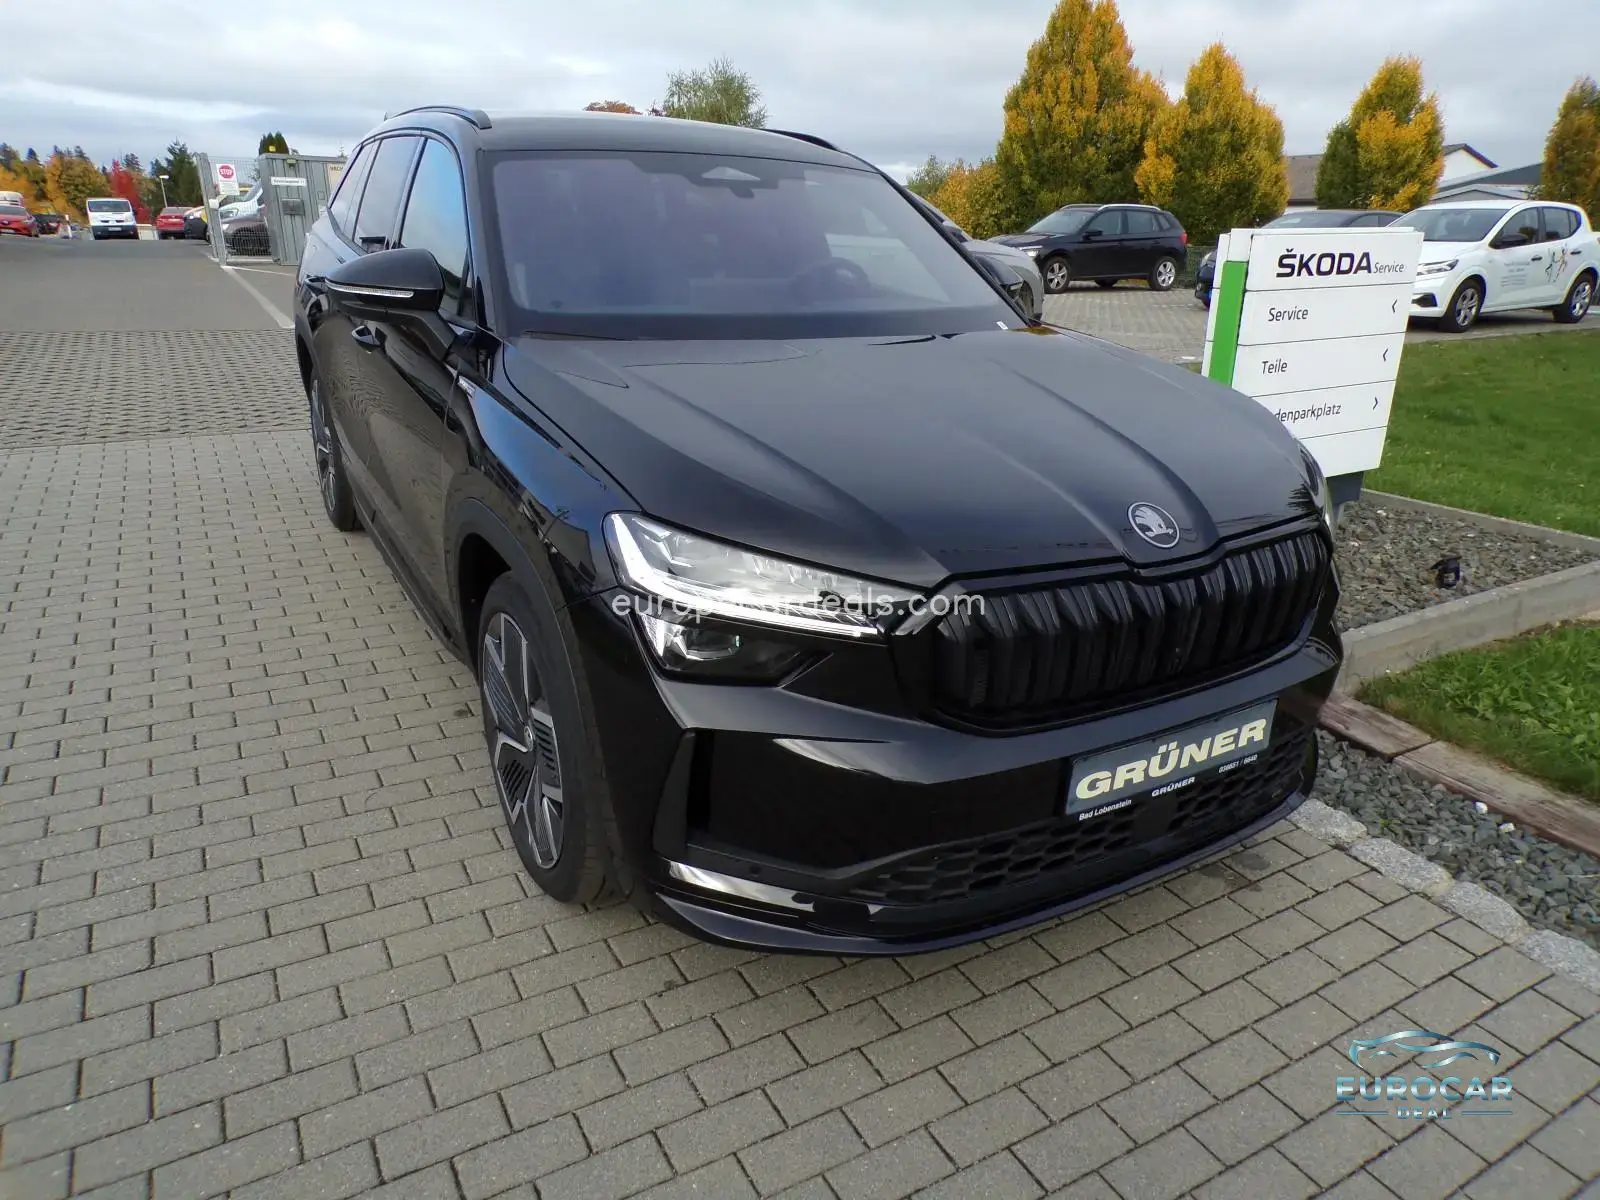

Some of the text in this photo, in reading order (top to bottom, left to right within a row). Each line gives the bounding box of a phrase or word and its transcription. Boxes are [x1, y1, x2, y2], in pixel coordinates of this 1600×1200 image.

[219, 168, 233, 176] STOP
[1276, 248, 1405, 277] ŠKODA Service
[1268, 306, 1309, 322] Service
[1262, 359, 1288, 375] Teile
[1076, 719, 1266, 799] GRÜNER
[1152, 777, 1195, 797] GRÜNER
[1079, 799, 1131, 820] Bad Lobenstein
